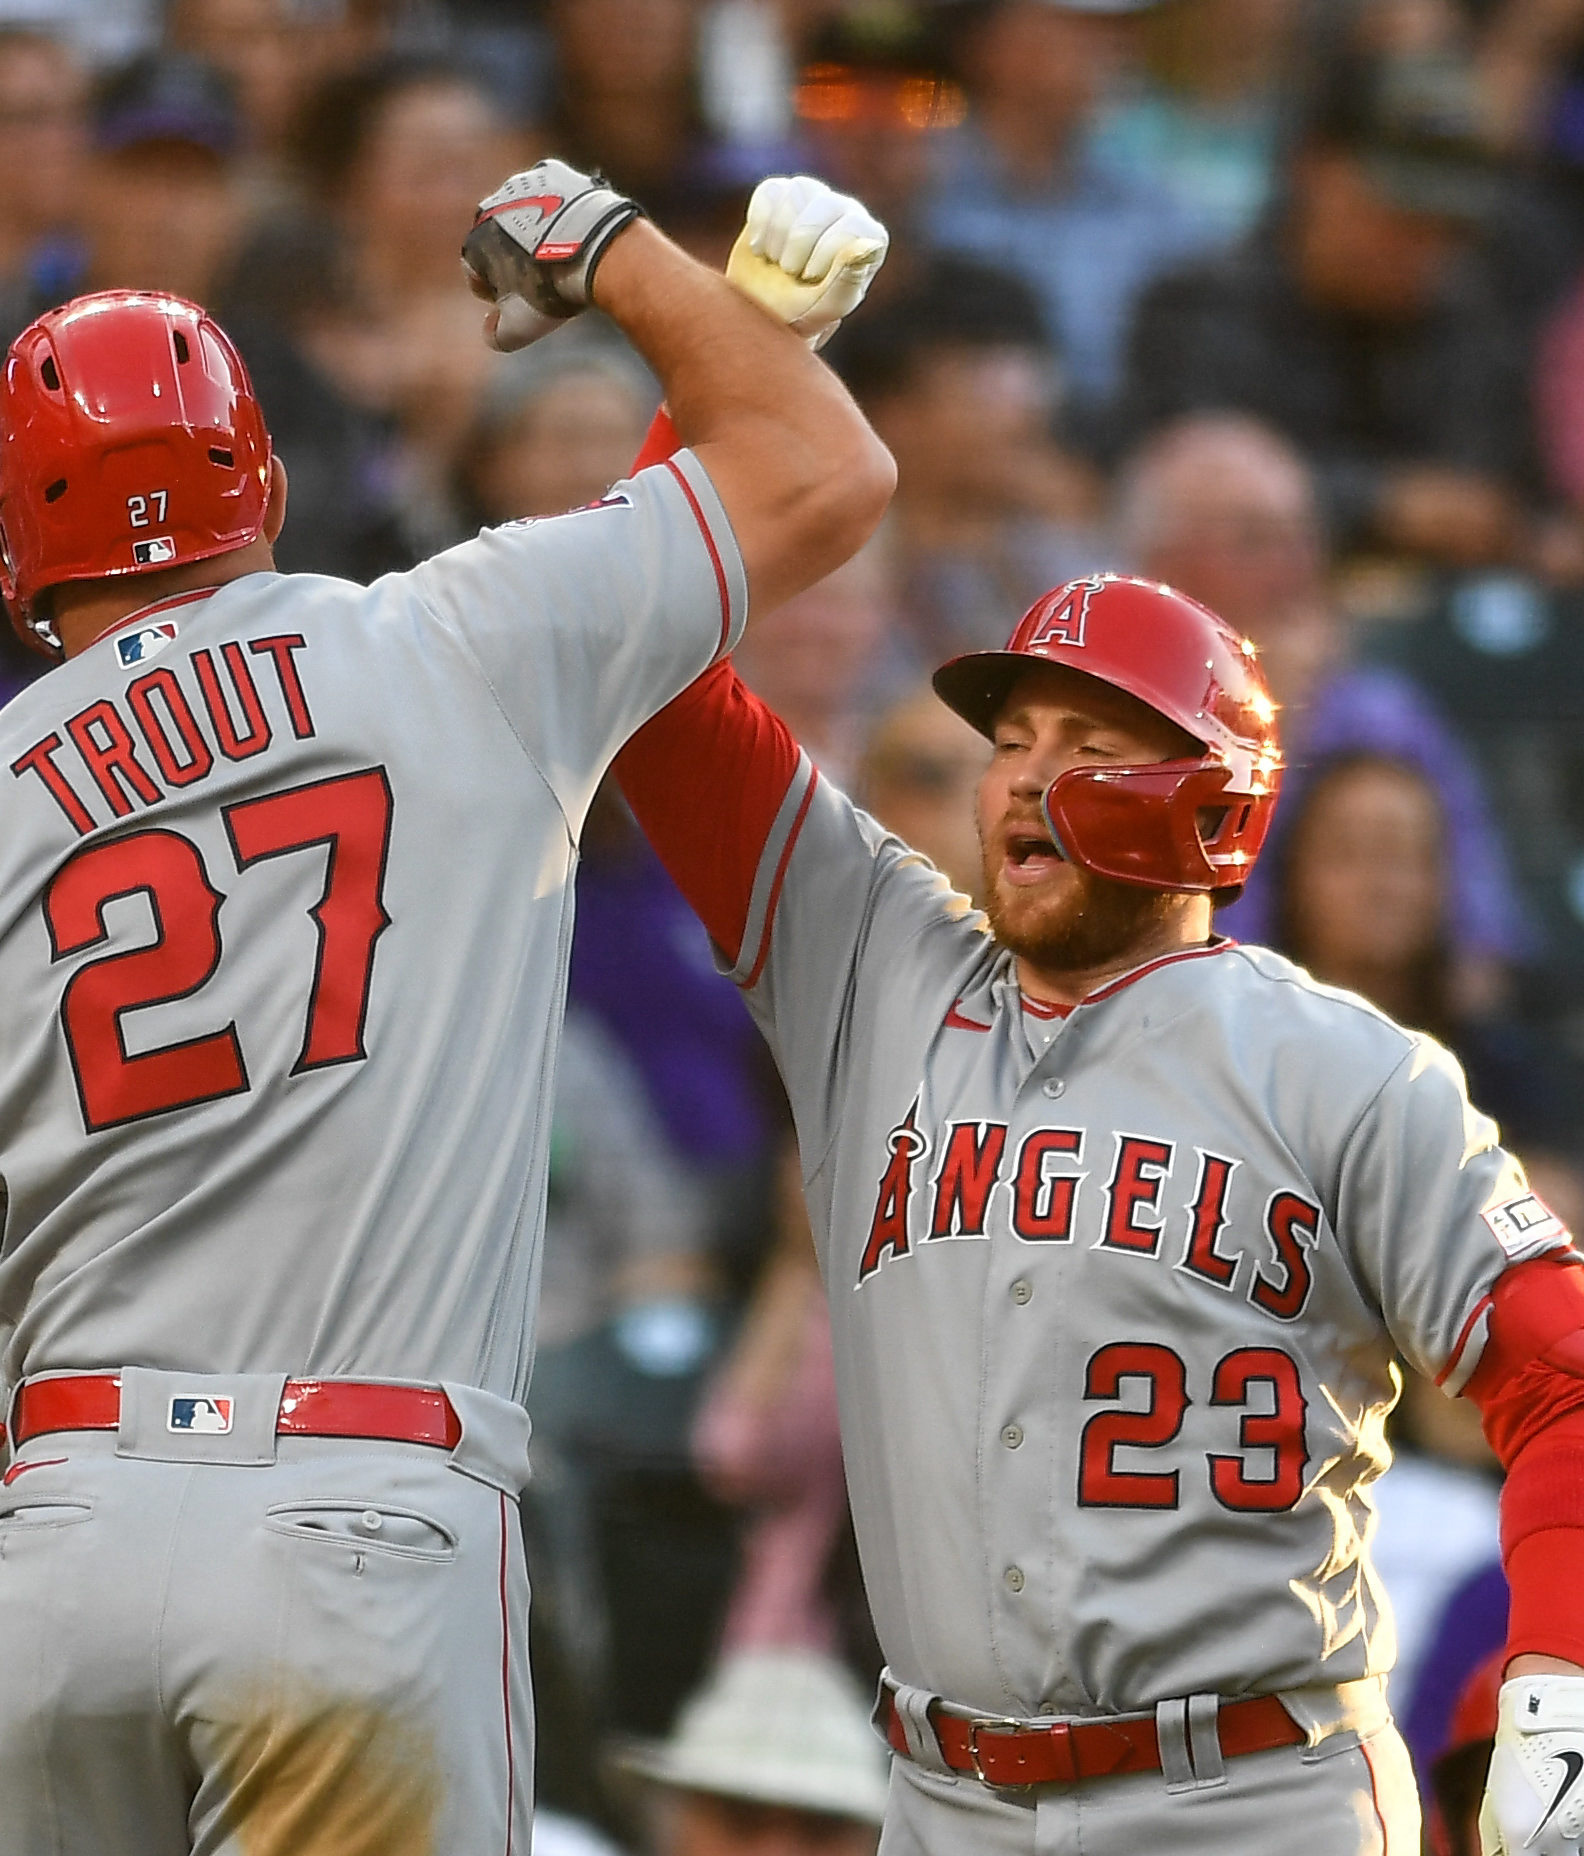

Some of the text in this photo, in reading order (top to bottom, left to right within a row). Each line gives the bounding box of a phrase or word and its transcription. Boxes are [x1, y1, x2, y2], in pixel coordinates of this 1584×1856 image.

[127, 491, 169, 528] 27
[1027, 579, 1106, 648] A
[9, 632, 317, 838] TROUT
[41, 764, 395, 1135] 27
[853, 1080, 1323, 1324] ANGELS
[1077, 1340, 1312, 1513] 23
